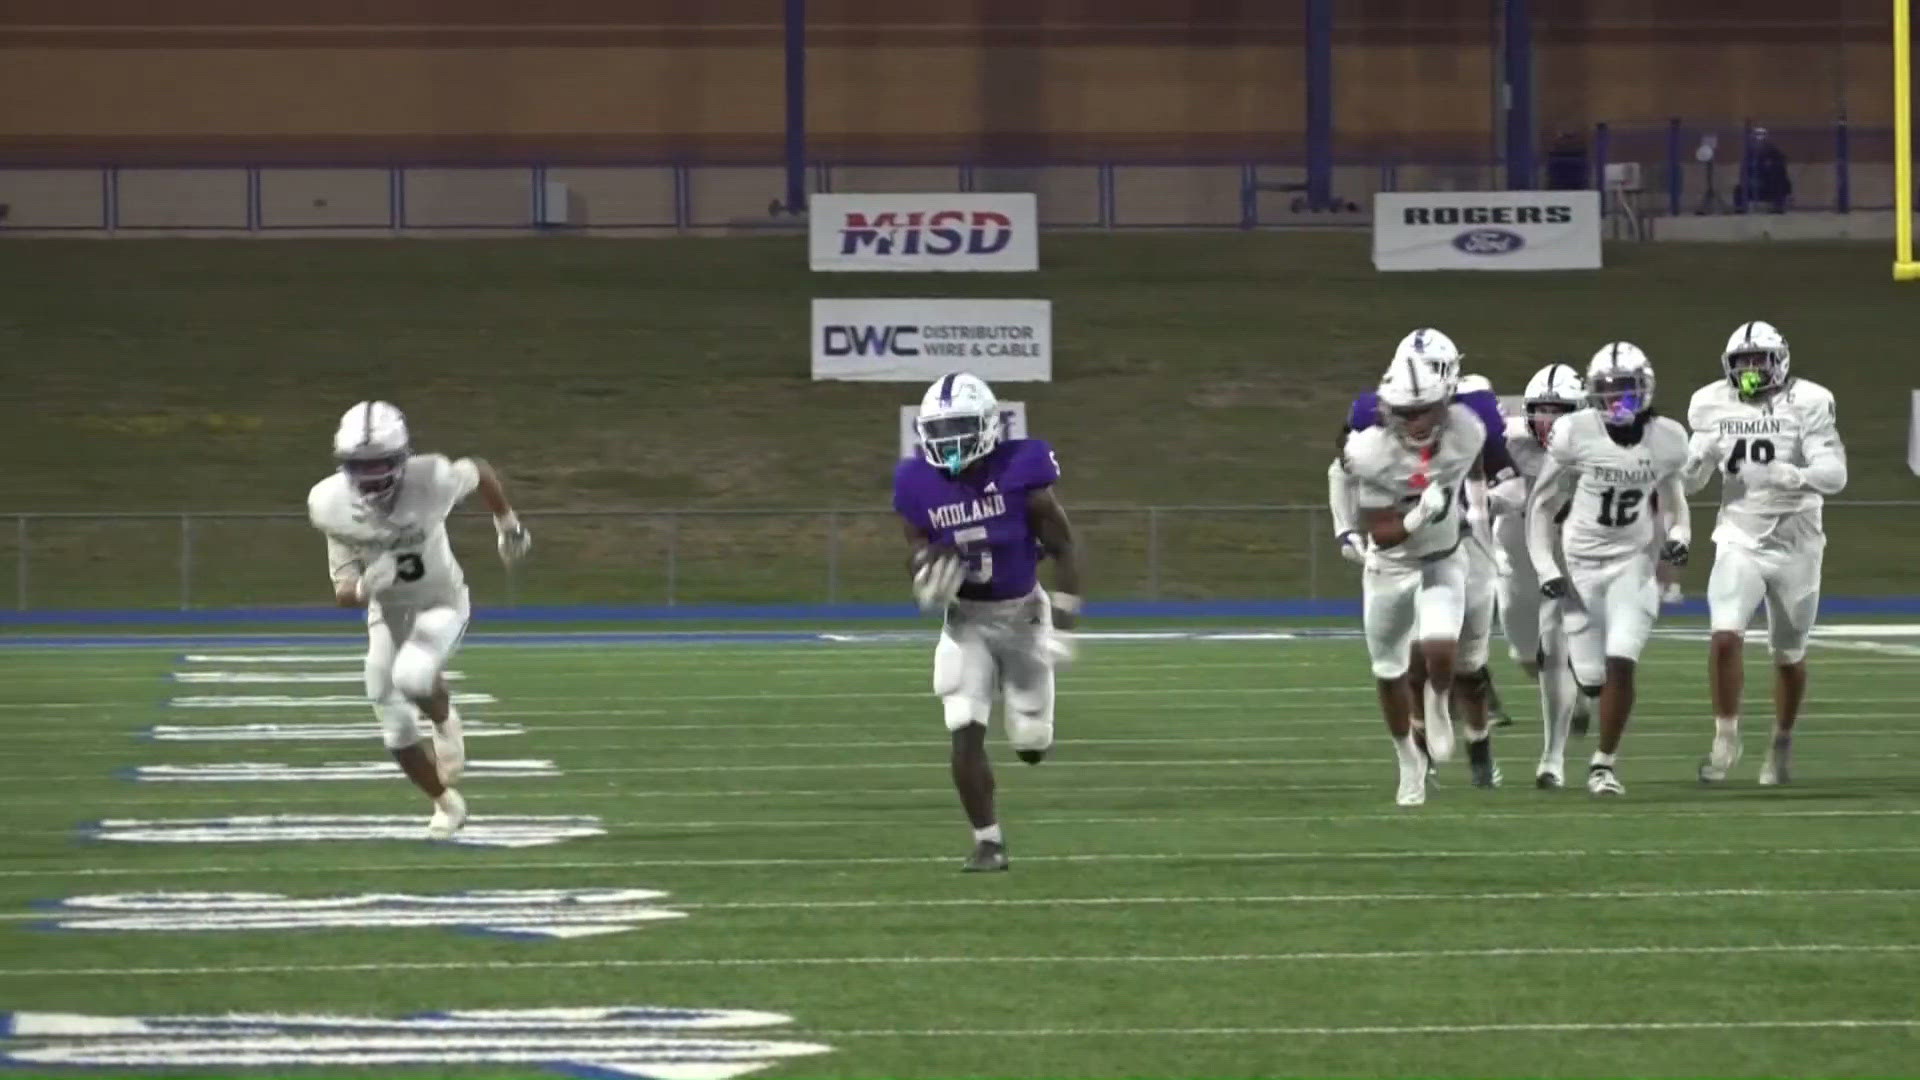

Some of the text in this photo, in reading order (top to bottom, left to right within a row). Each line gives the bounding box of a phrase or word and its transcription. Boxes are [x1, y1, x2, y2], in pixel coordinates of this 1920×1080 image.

[1403, 206, 1572, 225] ROGERS
[839, 210, 1013, 256] MISD
[823, 325, 919, 357] DWC
[923, 326, 1034, 340] DISTRIBUTOR
[923, 343, 1041, 357] WIRE & CABLE
[1719, 420, 1781, 435] PERMIAN
[1593, 466, 1658, 484] PERMIAN
[927, 494, 1006, 529] MIDLAND
[1597, 486, 1644, 527] 12
[953, 525, 993, 584] 5
